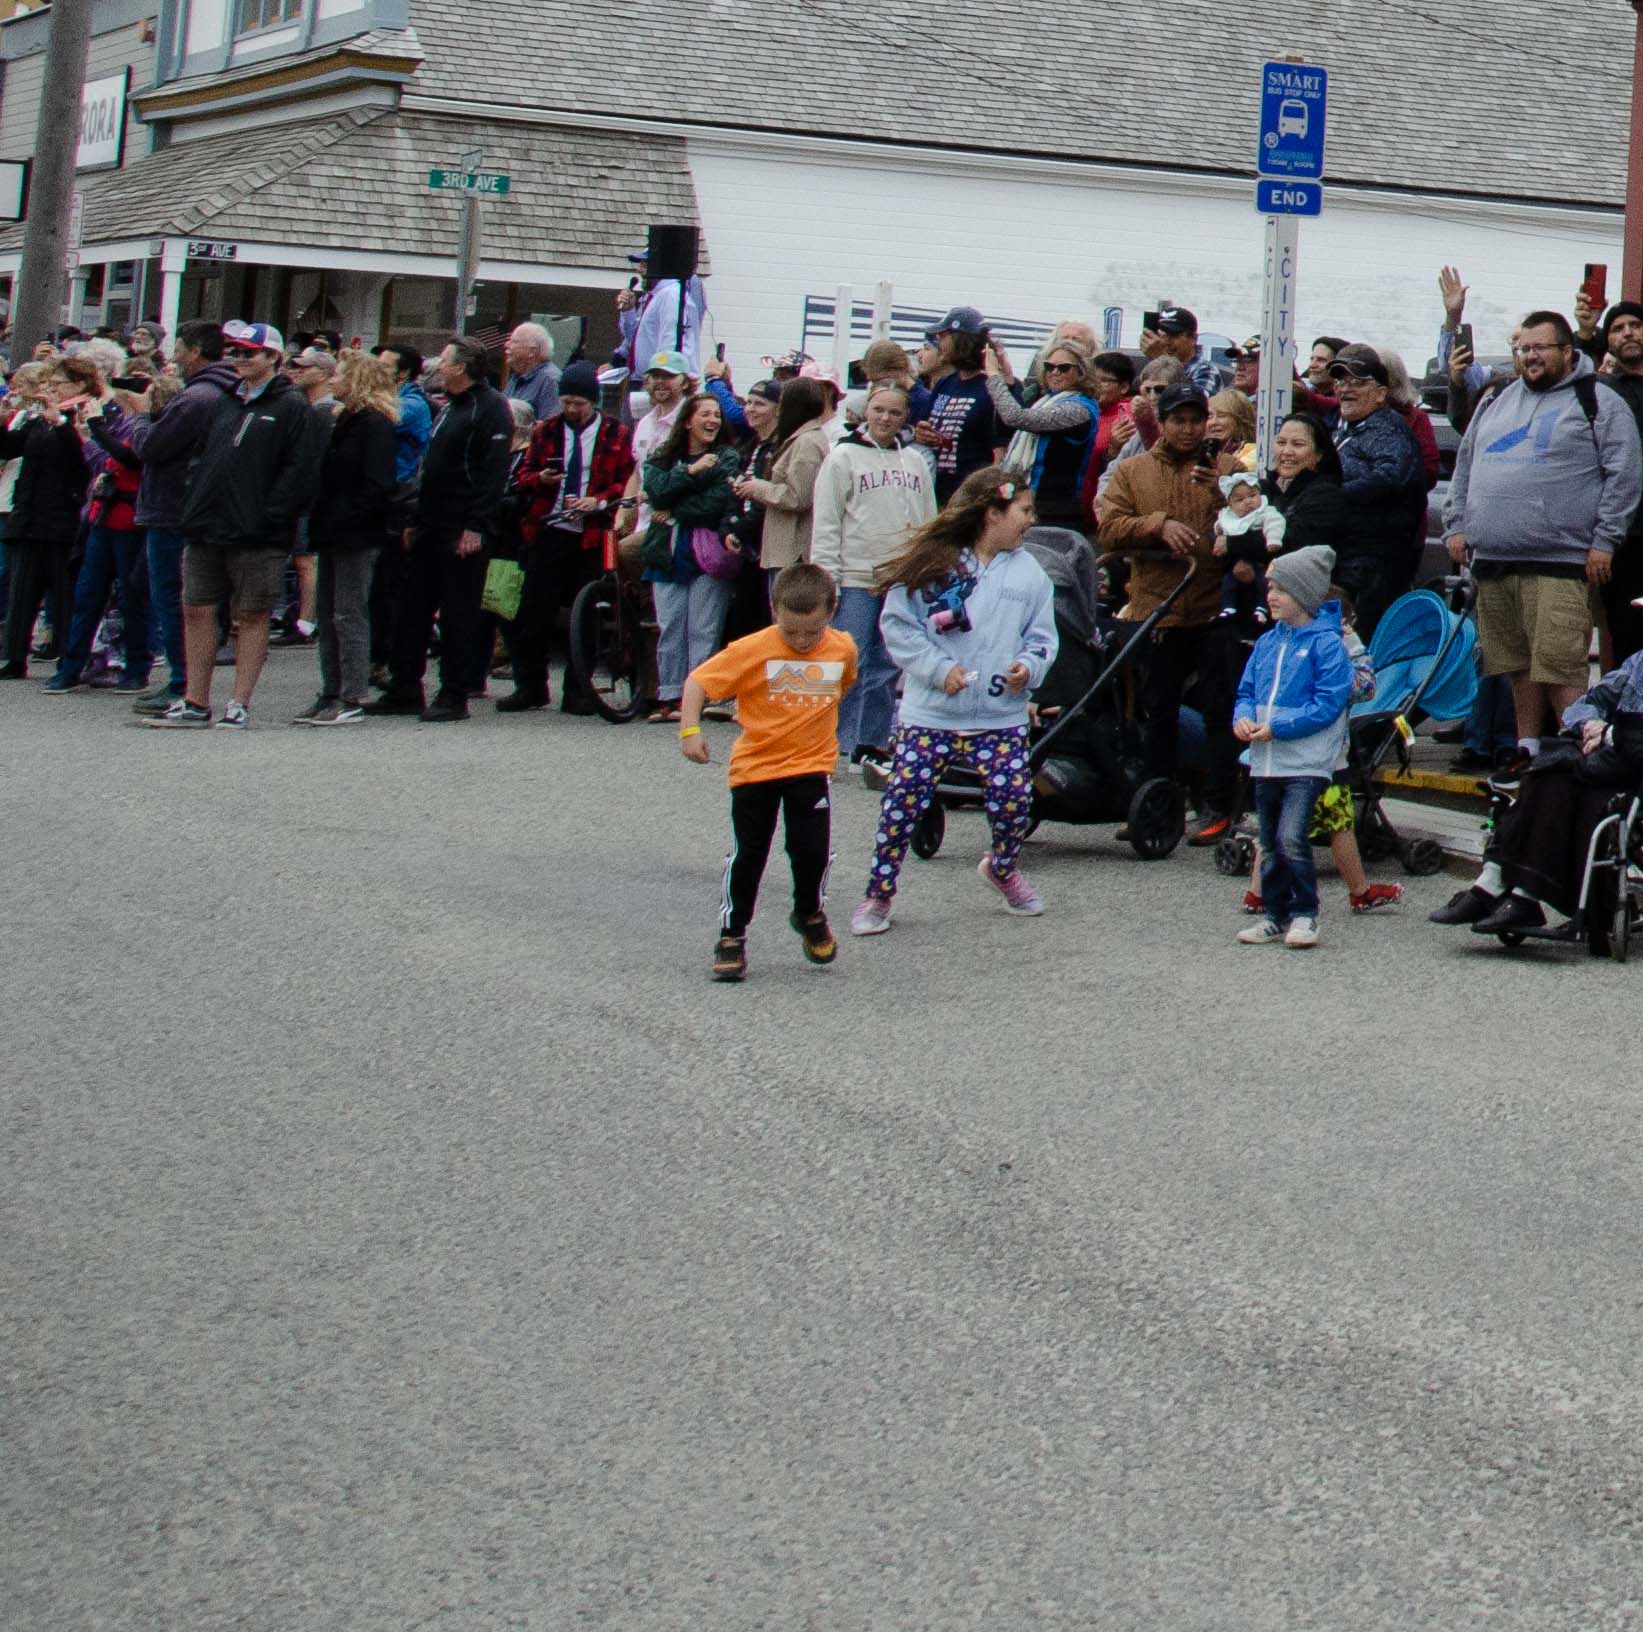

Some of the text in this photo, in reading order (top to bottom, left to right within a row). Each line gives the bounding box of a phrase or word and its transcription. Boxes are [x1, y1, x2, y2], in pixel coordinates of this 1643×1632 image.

[1268, 71, 1322, 90] SMART
[442, 171, 500, 192] 3RD AVE
[1271, 190, 1308, 207] END
[210, 244, 234, 258] AVE
[1278, 257, 1291, 358] CITY
[860, 469, 921, 494] ALASKA
